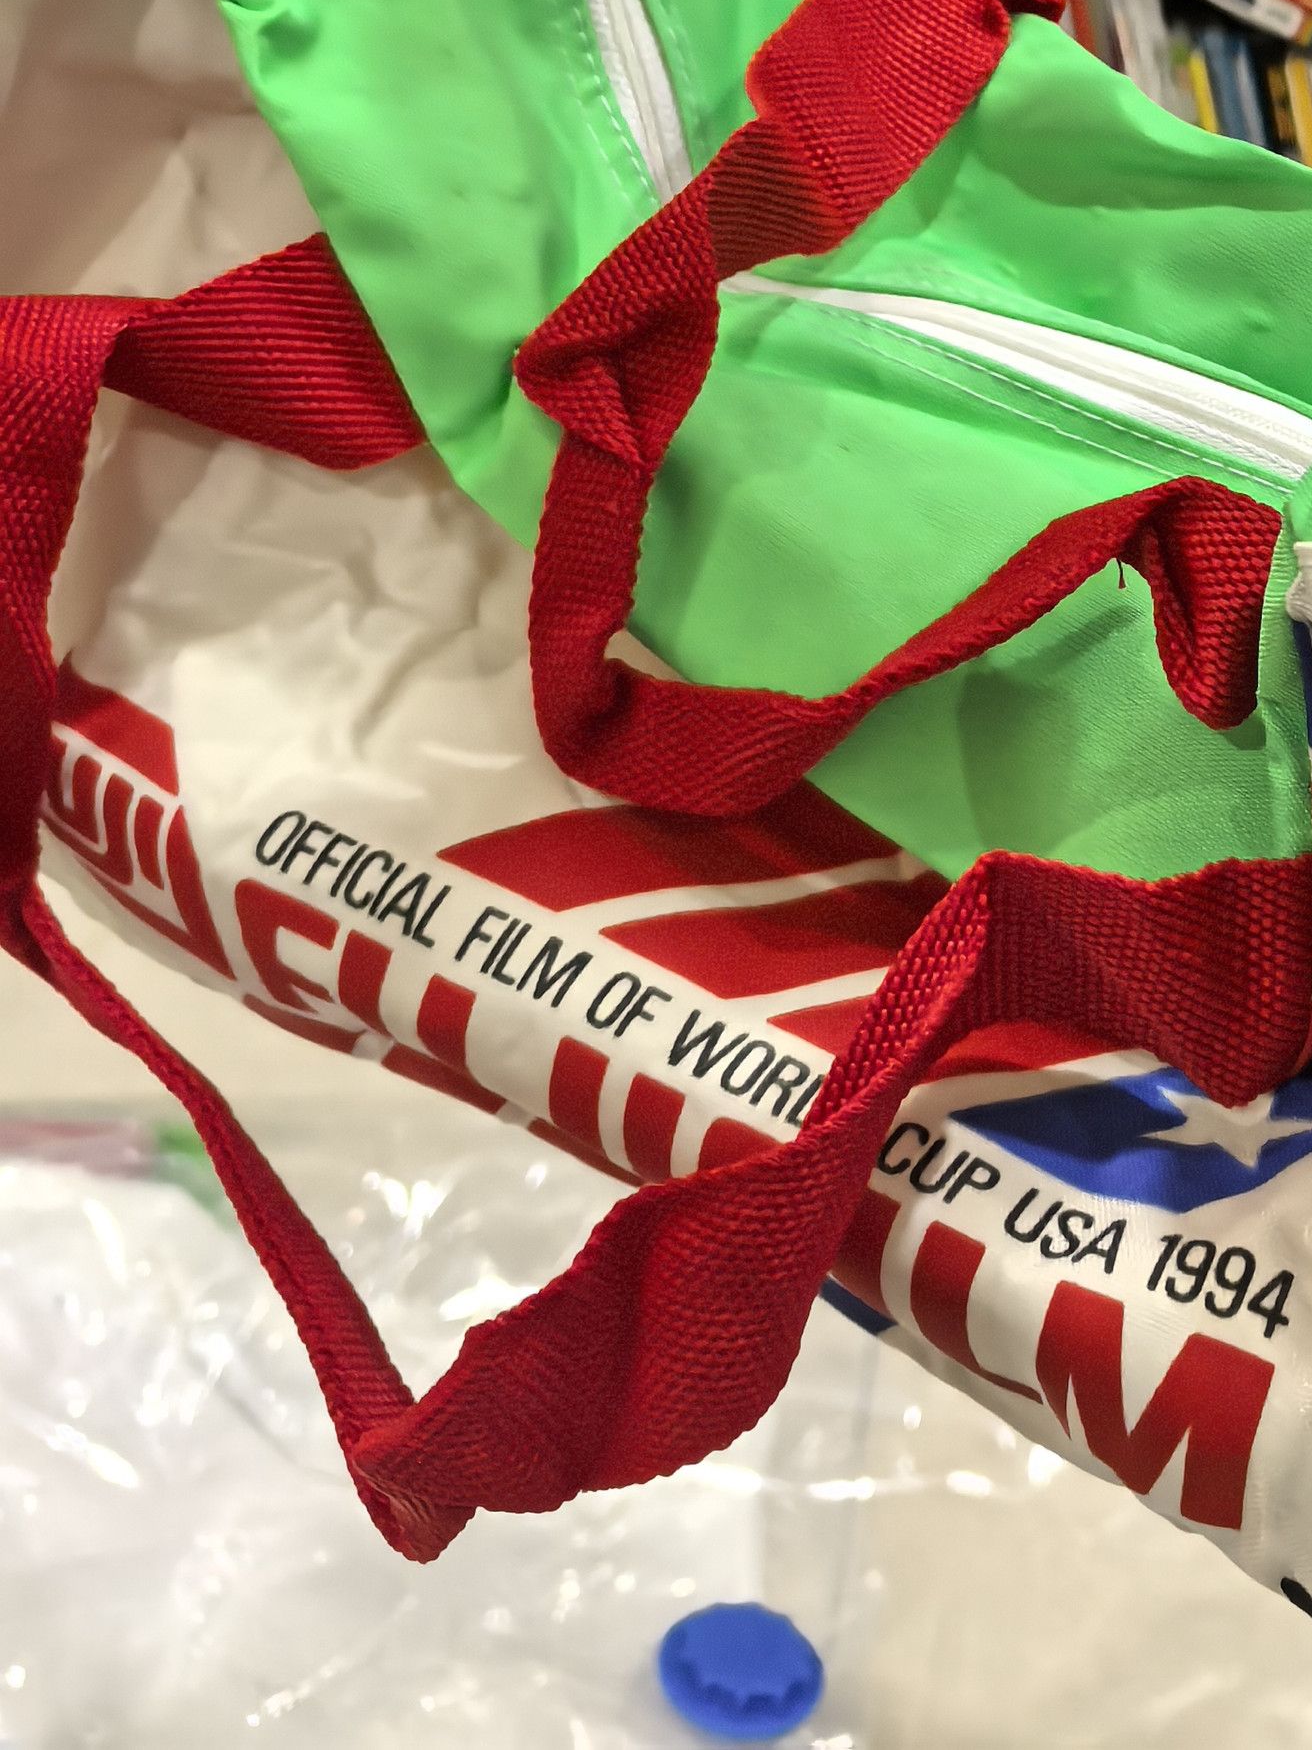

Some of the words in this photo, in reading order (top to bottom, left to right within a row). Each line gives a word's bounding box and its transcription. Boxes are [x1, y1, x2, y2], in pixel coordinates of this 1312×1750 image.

[255, 810, 452, 949] OFFICIAL
[454, 905, 594, 1009] FILM
[585, 970, 673, 1038] OF
[668, 1007, 826, 1130] WORL
[876, 1122, 1001, 1204] CUP
[1003, 1187, 1127, 1274] USA
[1146, 1232, 1296, 1339] 1994
